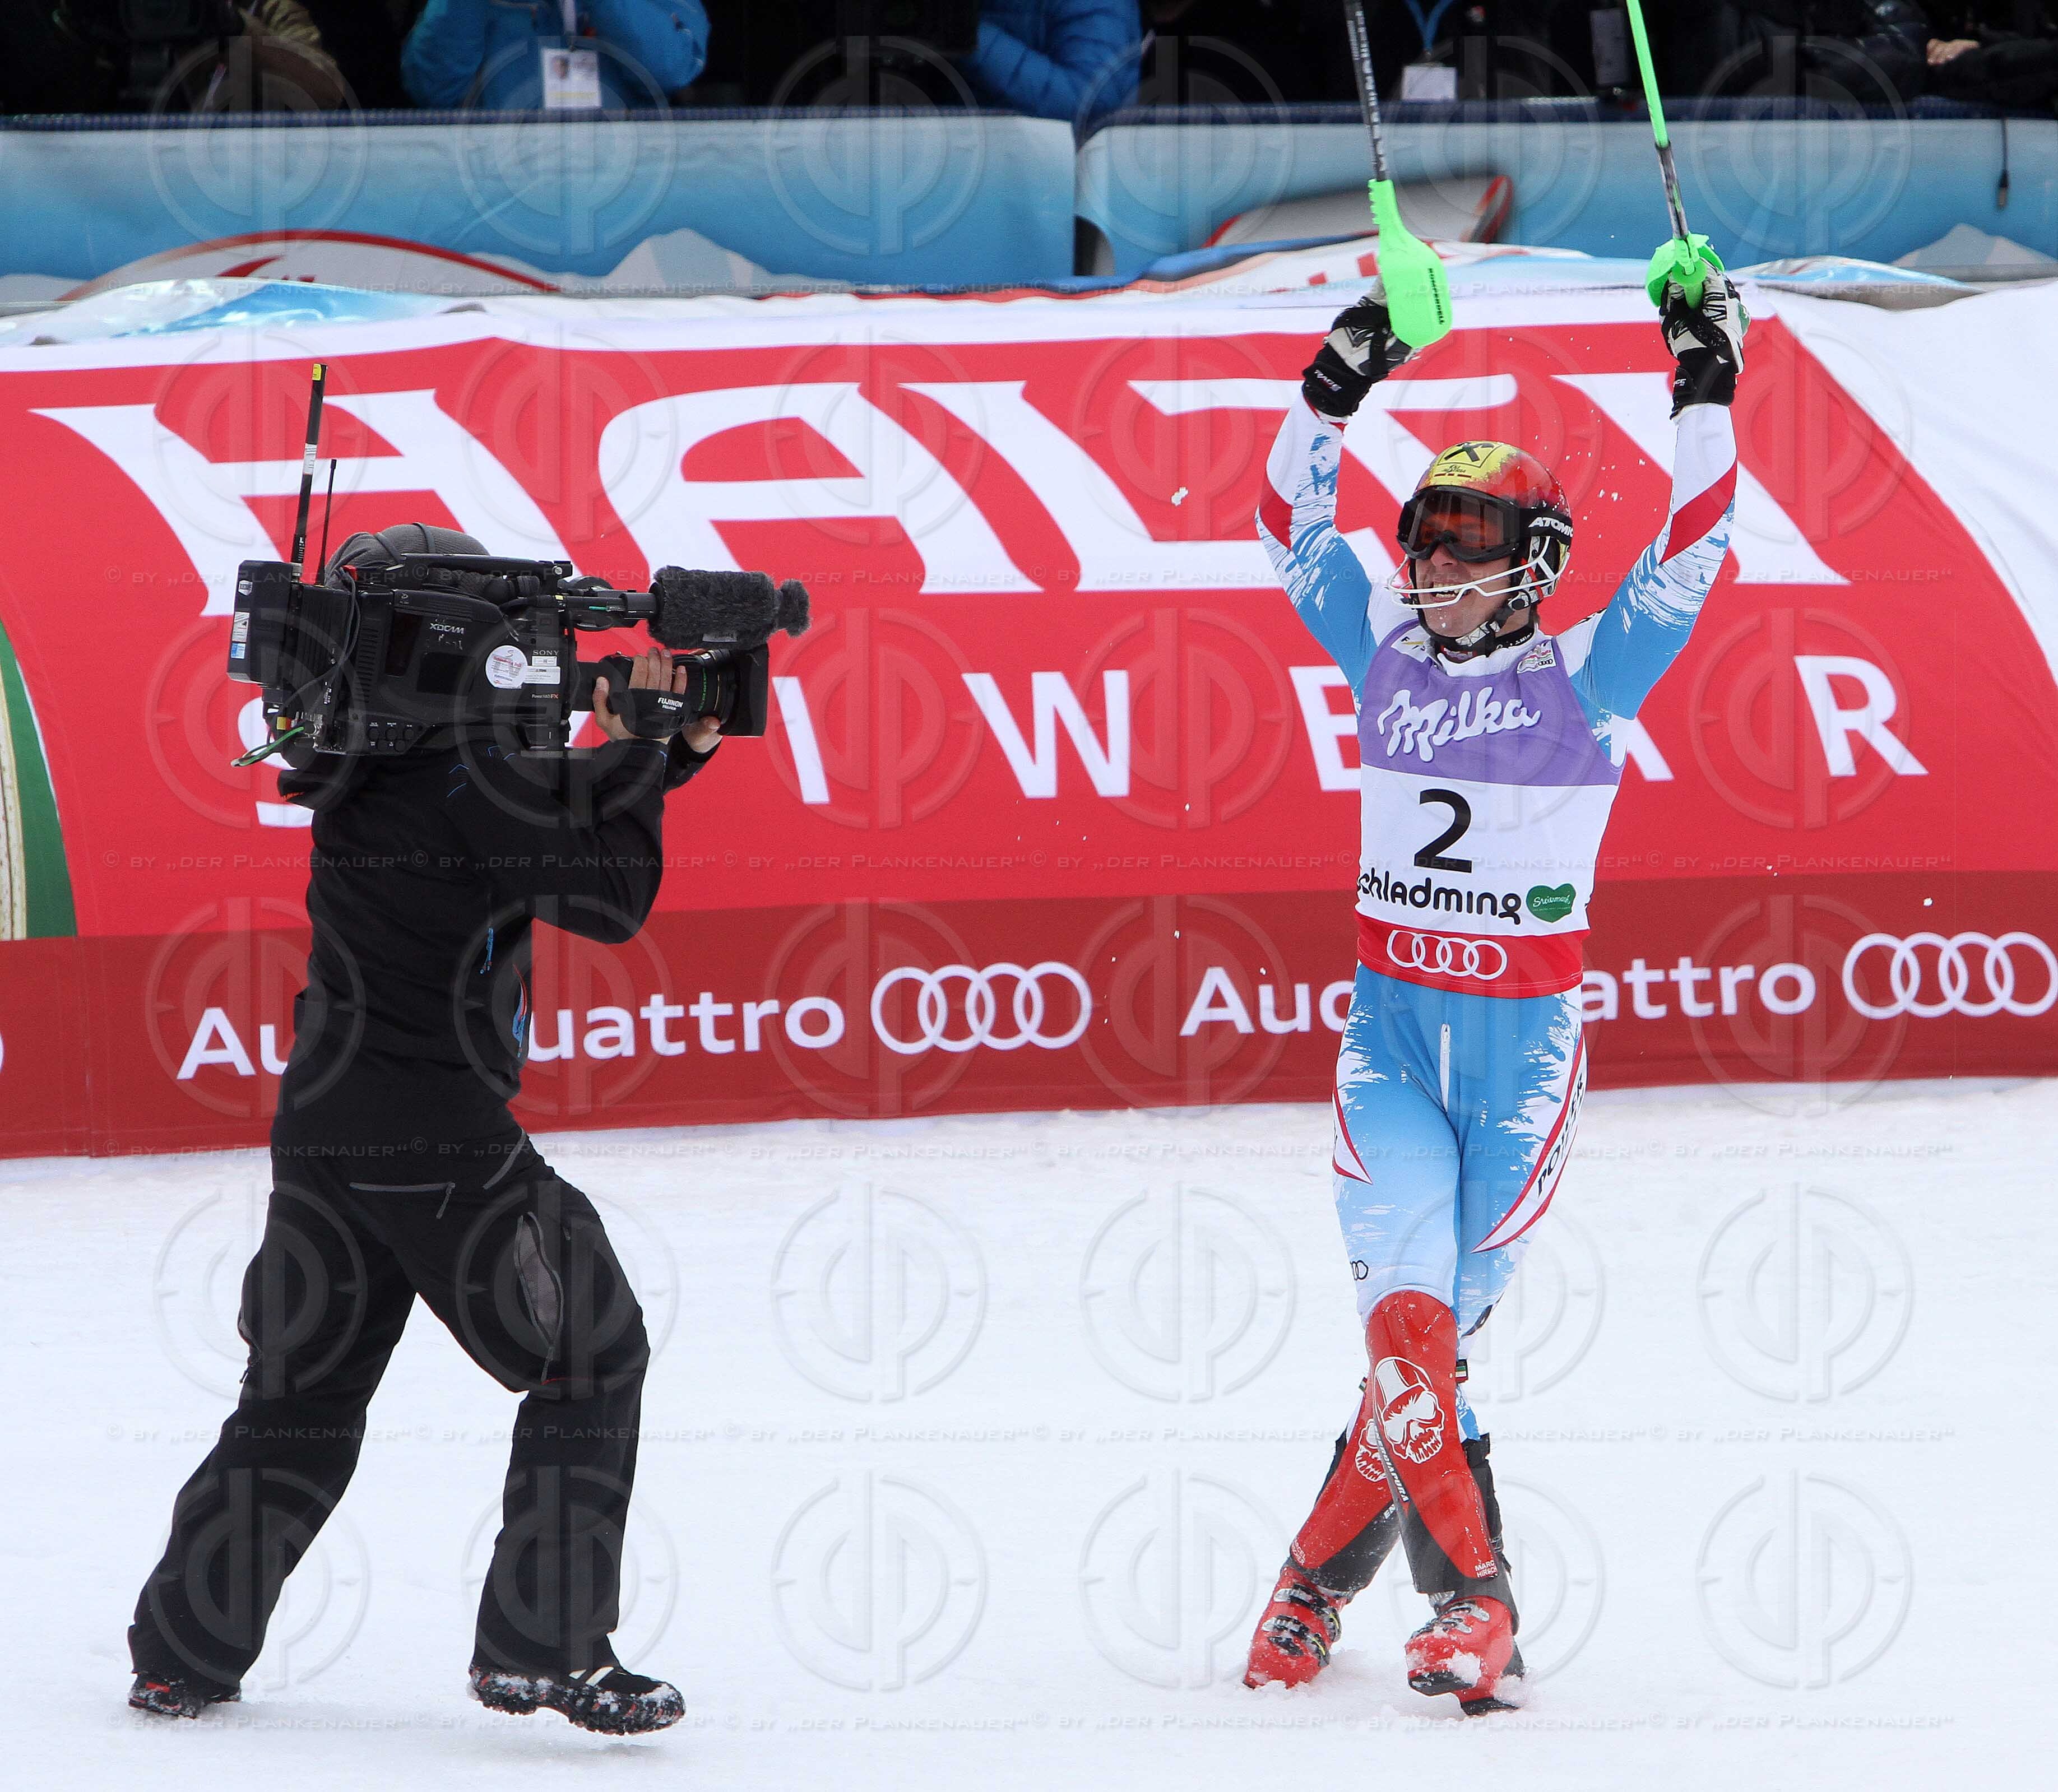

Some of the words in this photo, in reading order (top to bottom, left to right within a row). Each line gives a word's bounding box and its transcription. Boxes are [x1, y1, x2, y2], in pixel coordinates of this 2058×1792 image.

[1528, 517, 1574, 538] ATOMIC
[429, 623, 465, 634] XDCAM
[657, 697, 684, 708] FUJINON
[1377, 687, 1542, 763] Milka
[1413, 788, 1473, 874] 2
[1583, 956, 1817, 1023] attro
[176, 1006, 289, 1080] Au
[528, 991, 845, 1063] uattro
[1475, 1559, 1495, 1572] MARC
[1476, 1567, 1498, 1578] HIRSC
